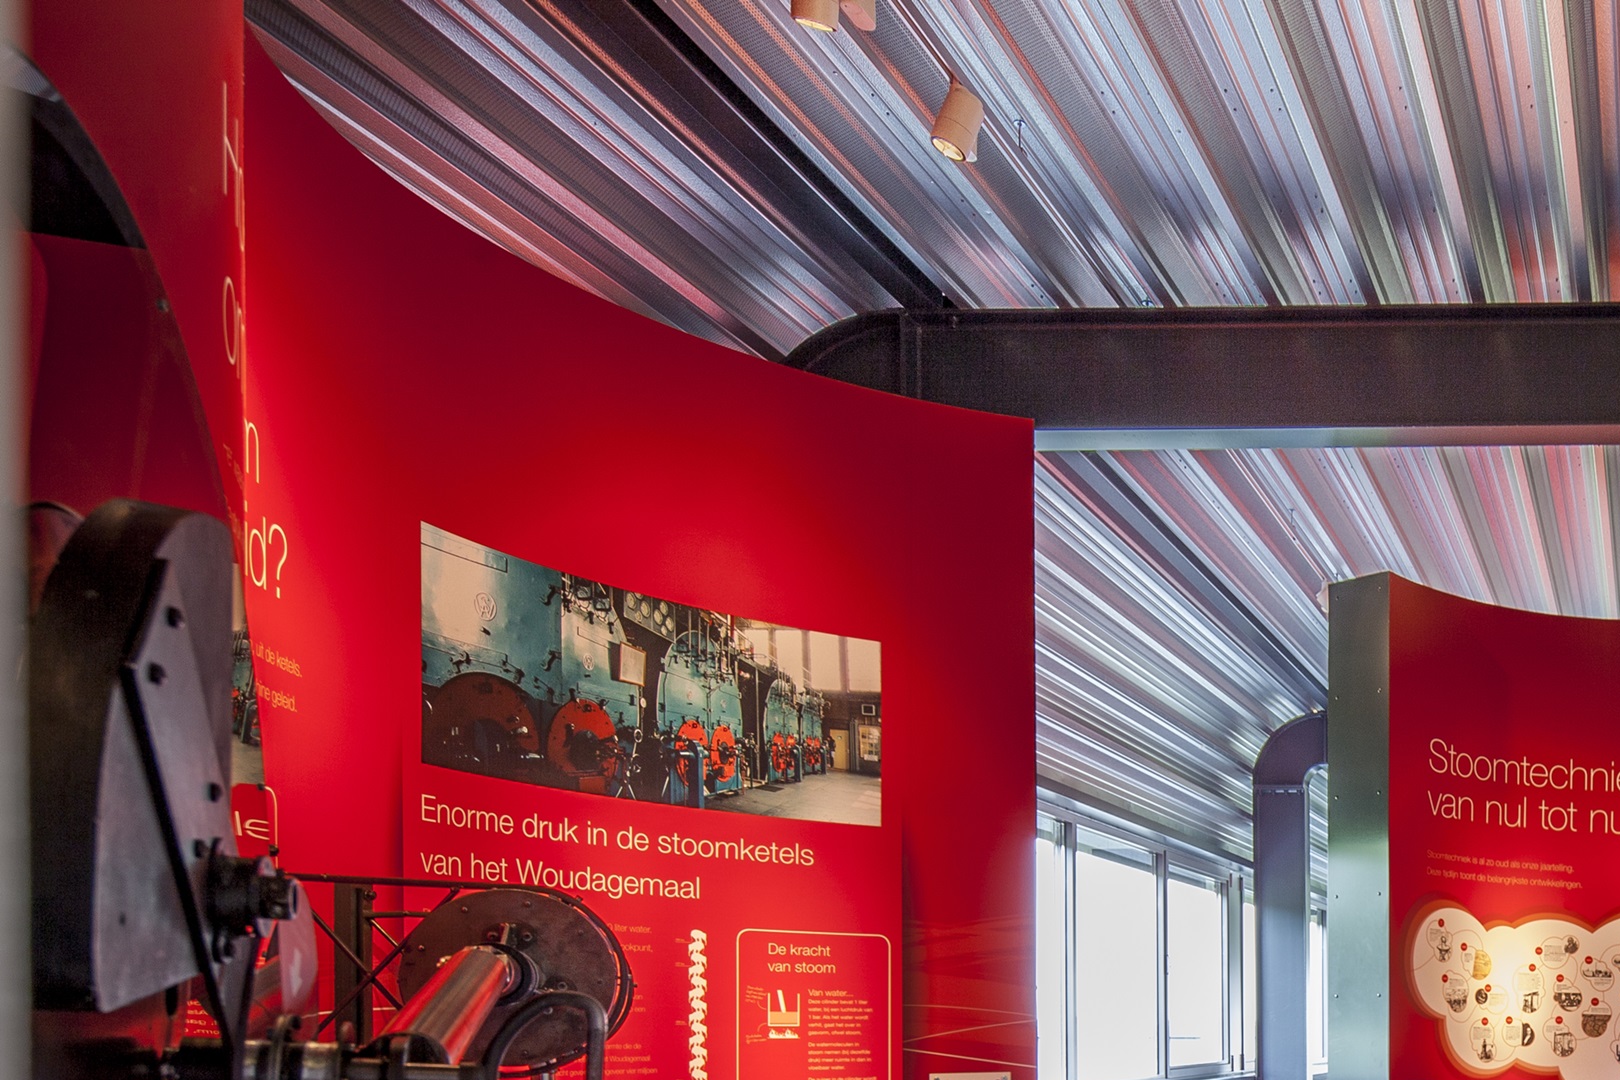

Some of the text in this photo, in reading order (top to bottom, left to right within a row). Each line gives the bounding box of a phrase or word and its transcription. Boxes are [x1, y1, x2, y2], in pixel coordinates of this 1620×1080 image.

[1428, 790, 1474, 822] van
[1486, 796, 1527, 828] nul
[1538, 800, 1578, 831] tot
[421, 794, 814, 866] Enorme druk in de stoomketels
[420, 852, 701, 900] van het Woudagemaal
[768, 943, 831, 956] De kracht
[768, 962, 836, 973] van stoom
[808, 988, 824, 997] Van
